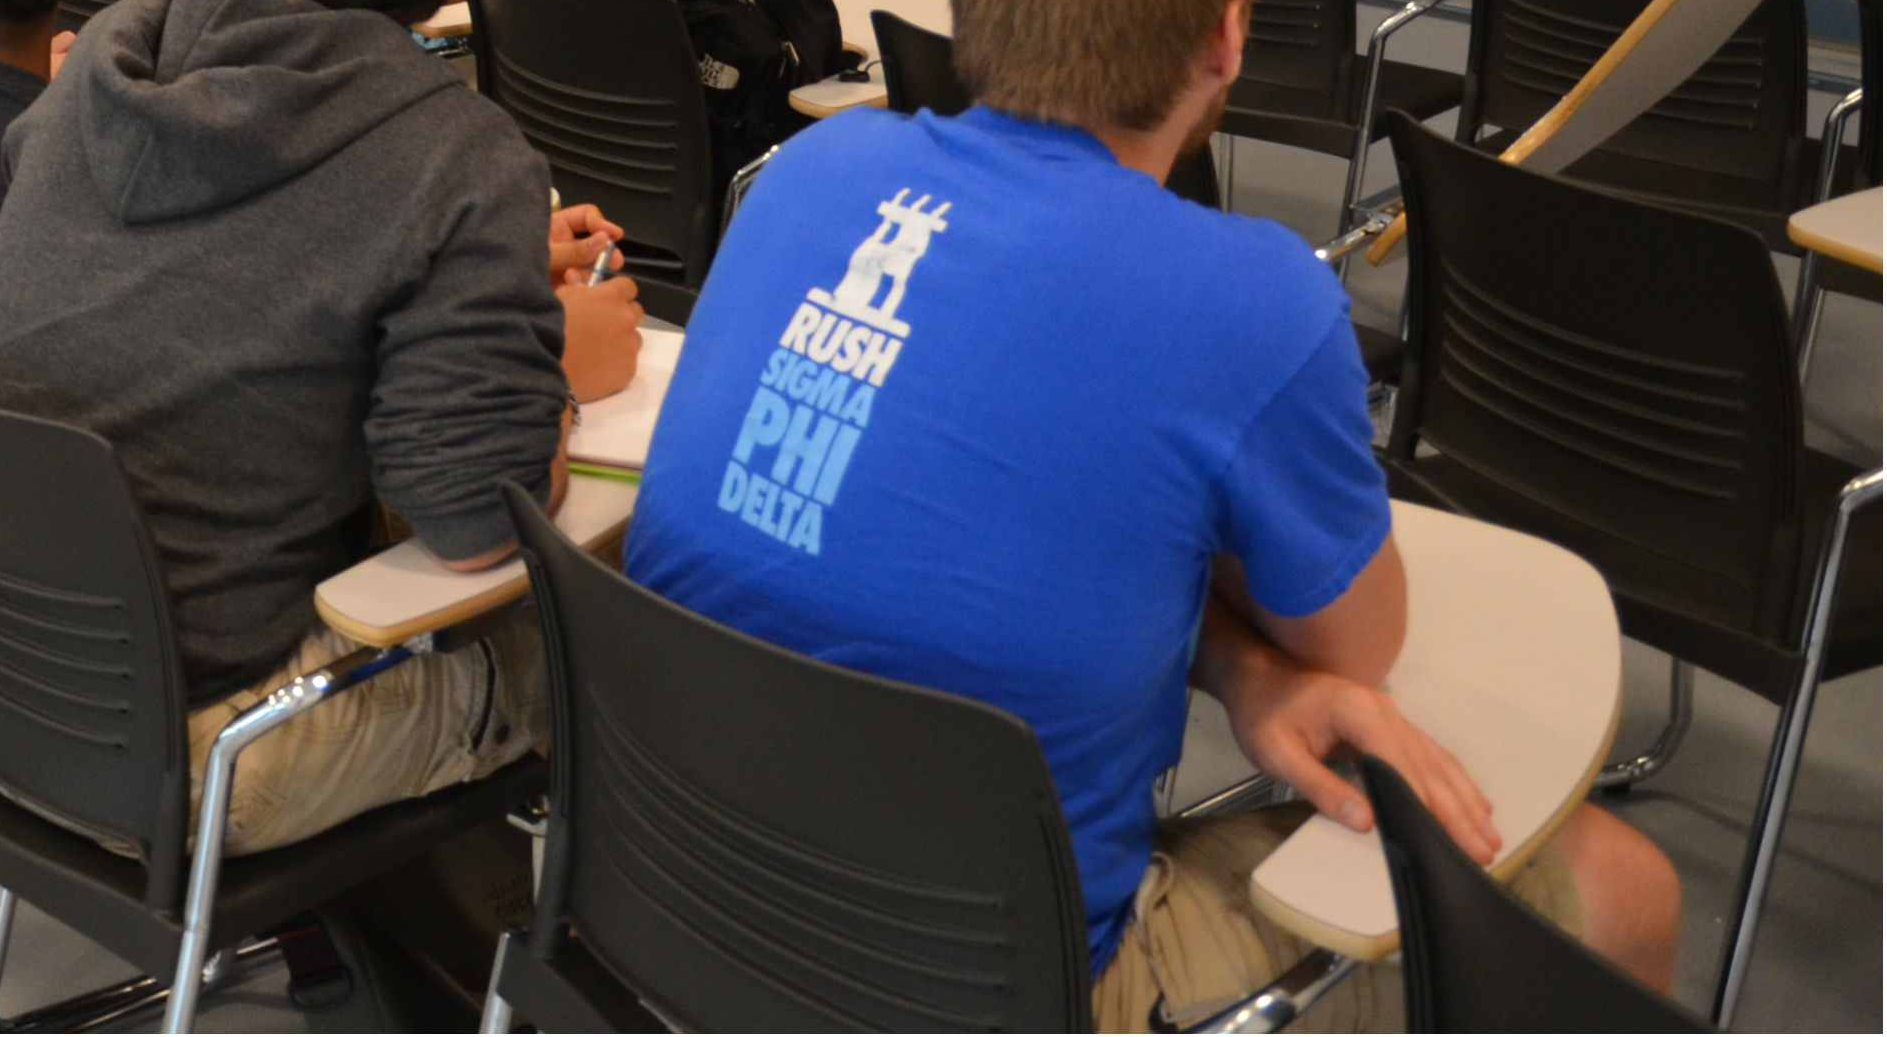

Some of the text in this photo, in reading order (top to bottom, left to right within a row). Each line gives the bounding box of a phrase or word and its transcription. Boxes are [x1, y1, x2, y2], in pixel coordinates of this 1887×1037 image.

[759, 347, 876, 429] SIGMA
[778, 300, 903, 389] RUSH
[730, 385, 862, 507] PHI
[716, 458, 824, 557] DELTA
